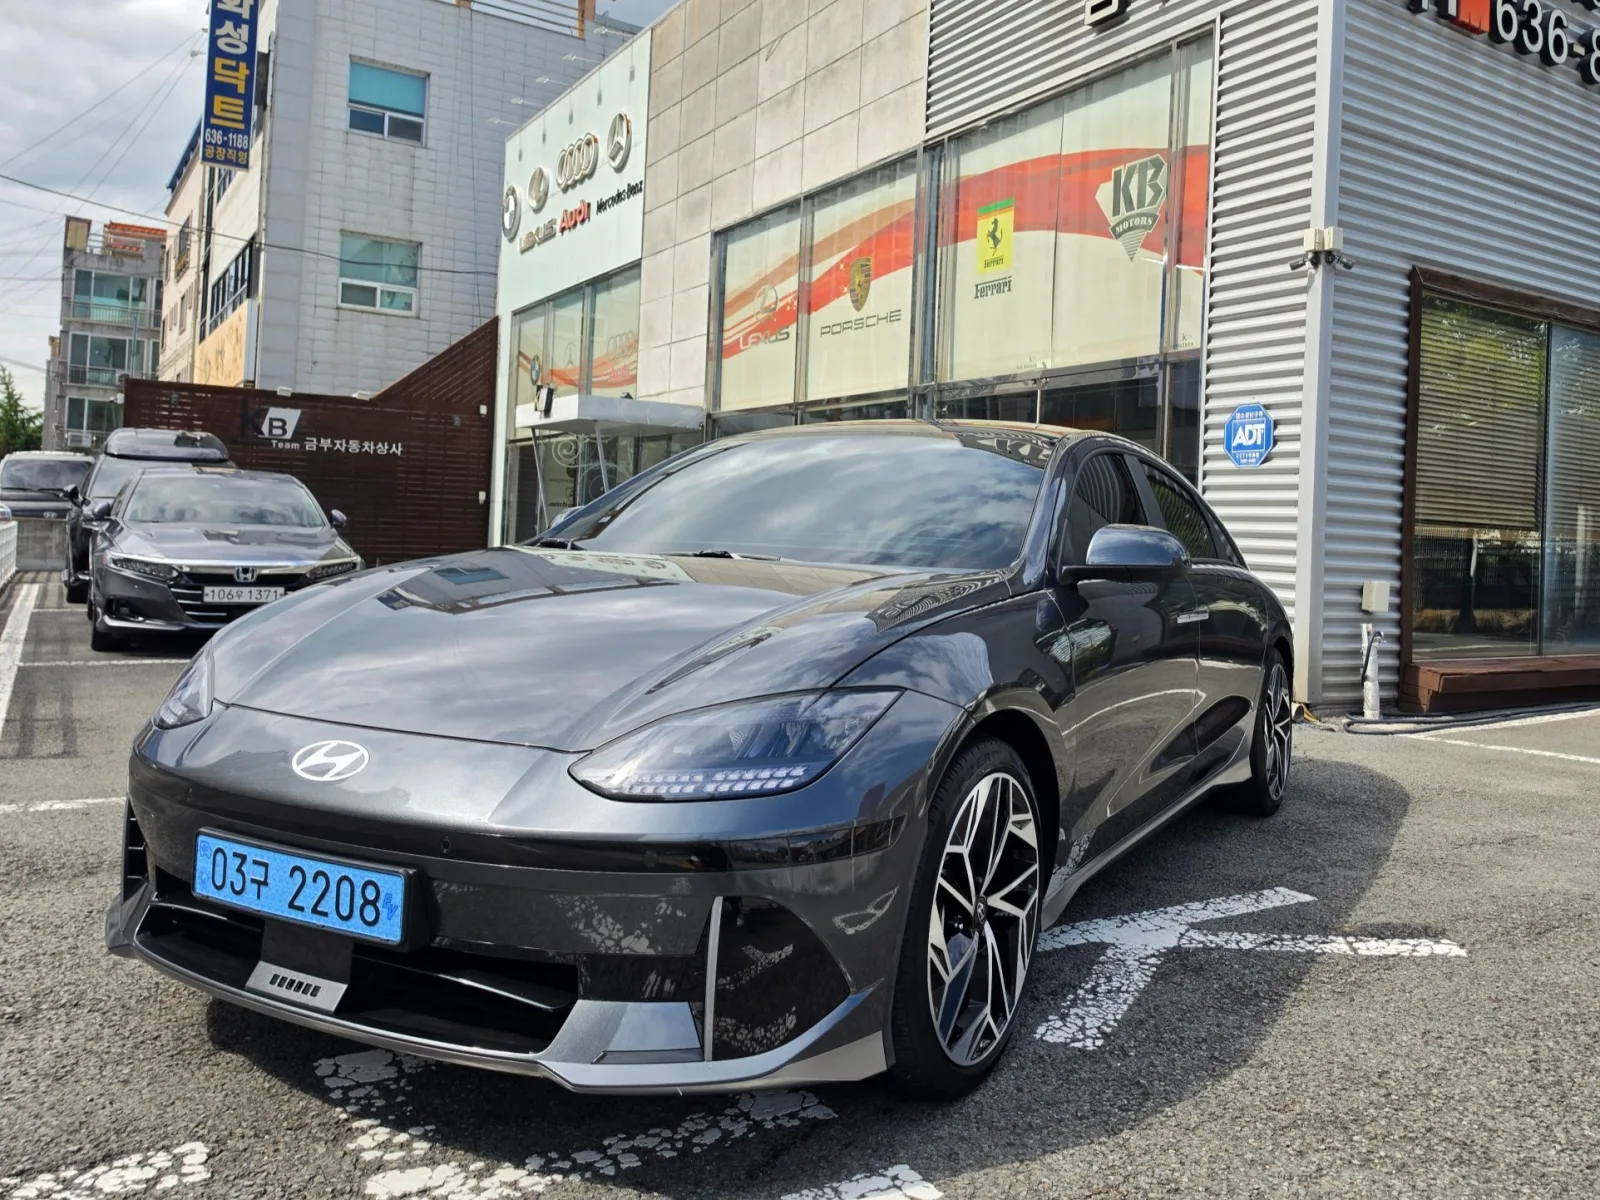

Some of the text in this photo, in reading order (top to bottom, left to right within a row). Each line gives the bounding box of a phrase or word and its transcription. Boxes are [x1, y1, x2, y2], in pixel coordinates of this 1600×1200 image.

[205, 128, 249, 149] 636-1188
[205, 145, 248, 165] 공장직영
[1112, 154, 1166, 217] KB
[559, 200, 592, 236] Audi
[1115, 216, 1154, 235] MOTORS
[984, 256, 1004, 269] Ferrari
[974, 275, 1012, 299] Ferrari
[820, 309, 902, 337] PORSCHE
[739, 326, 790, 350] LEXUS
[271, 437, 403, 456] Team 금부자동차상사
[1232, 423, 1265, 447] ADT
[247, 588, 279, 601] 1371
[211, 847, 381, 927] 03구 2208
